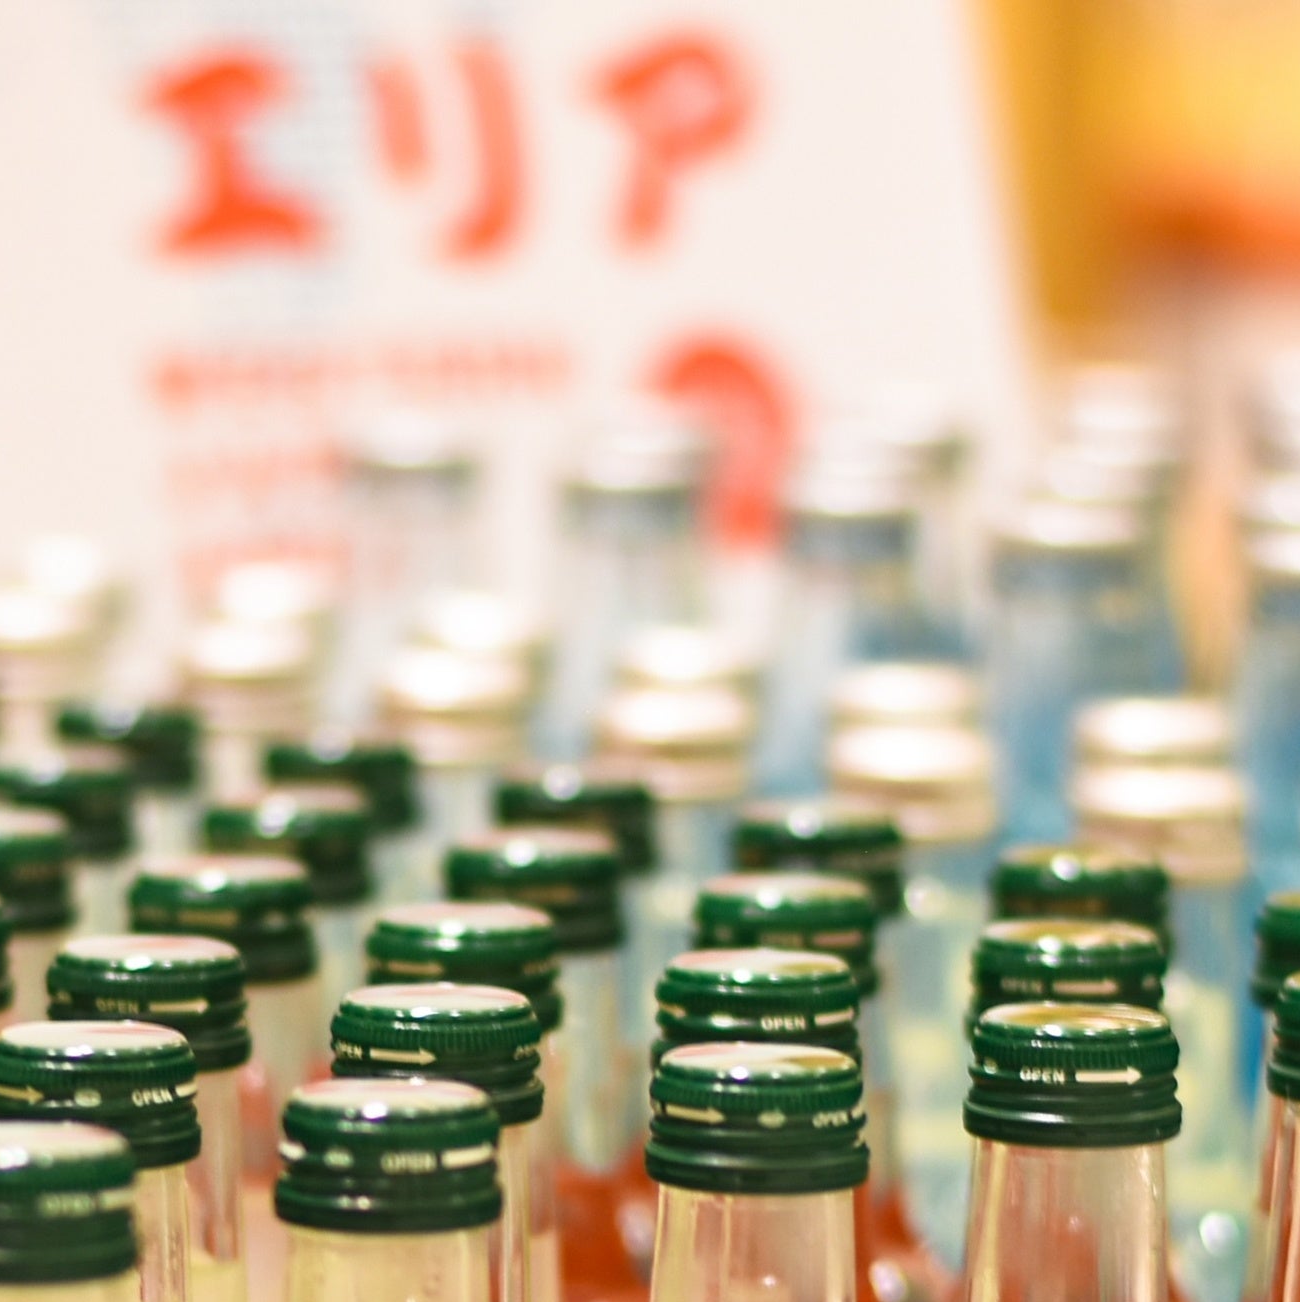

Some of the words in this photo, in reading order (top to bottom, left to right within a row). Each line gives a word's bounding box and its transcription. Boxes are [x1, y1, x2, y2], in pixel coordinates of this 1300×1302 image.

[96, 996, 140, 1015] OPEN
[760, 1015, 807, 1032] OPEN
[1019, 1067, 1067, 1086] OPEN
[131, 1086, 175, 1107] OPEN
[812, 1110, 850, 1130] OPEN
[380, 1151, 438, 1174] OPEN
